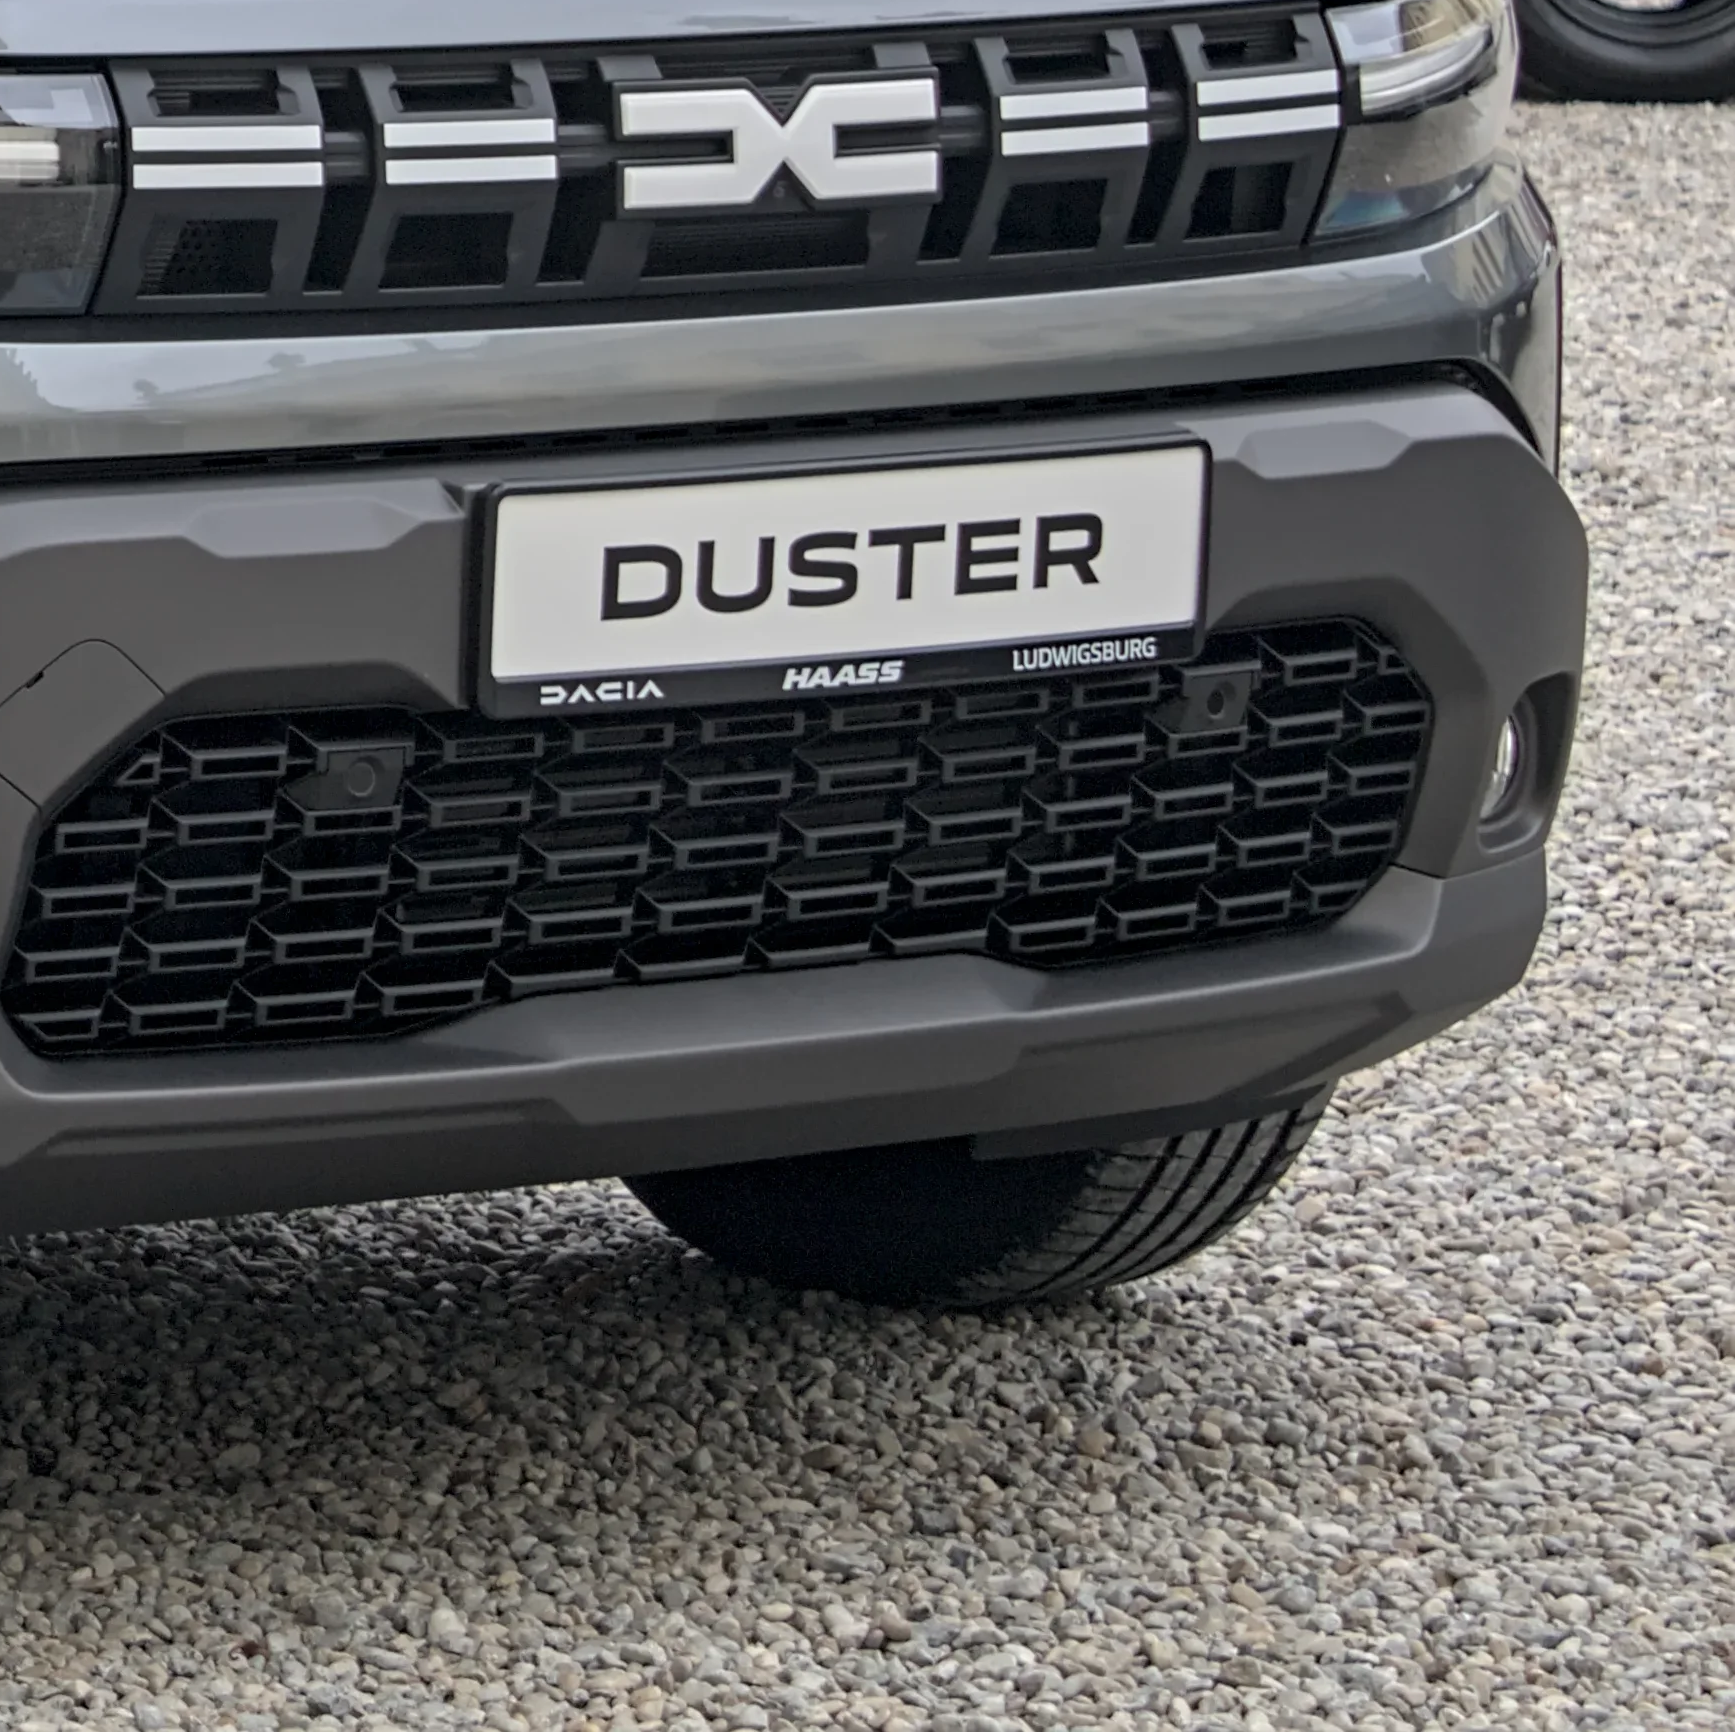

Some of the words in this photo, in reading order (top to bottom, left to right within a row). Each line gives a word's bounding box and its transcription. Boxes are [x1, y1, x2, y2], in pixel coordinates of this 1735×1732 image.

[600, 512, 1103, 622] DUSTER
[540, 679, 665, 706] DACIA
[782, 660, 904, 691] HAASS
[1013, 637, 1157, 672] LUDWIGSBURG
